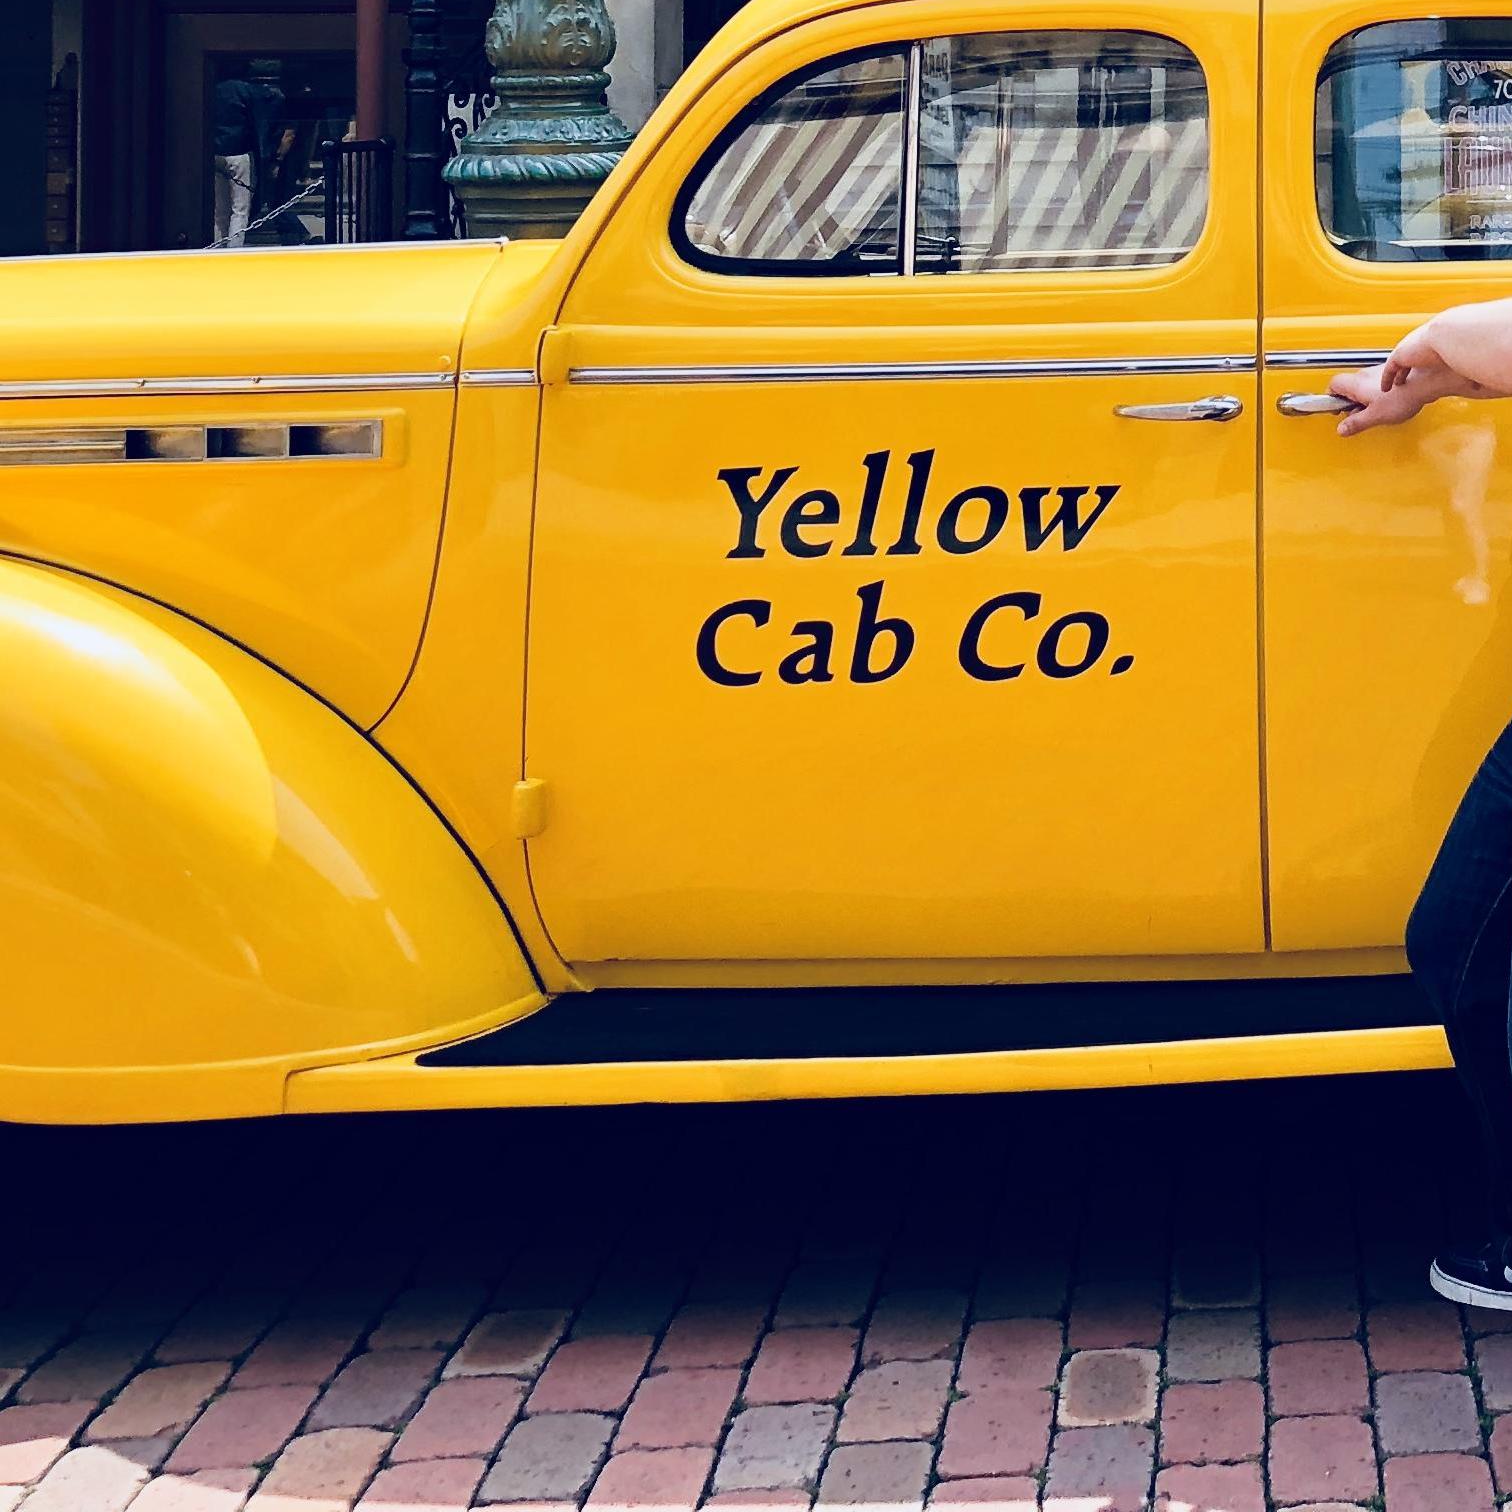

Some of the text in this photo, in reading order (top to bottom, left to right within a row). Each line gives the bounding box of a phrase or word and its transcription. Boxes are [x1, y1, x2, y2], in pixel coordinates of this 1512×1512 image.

[716, 448, 1122, 559] Yellow
[695, 579, 1135, 687] Cab Co.
